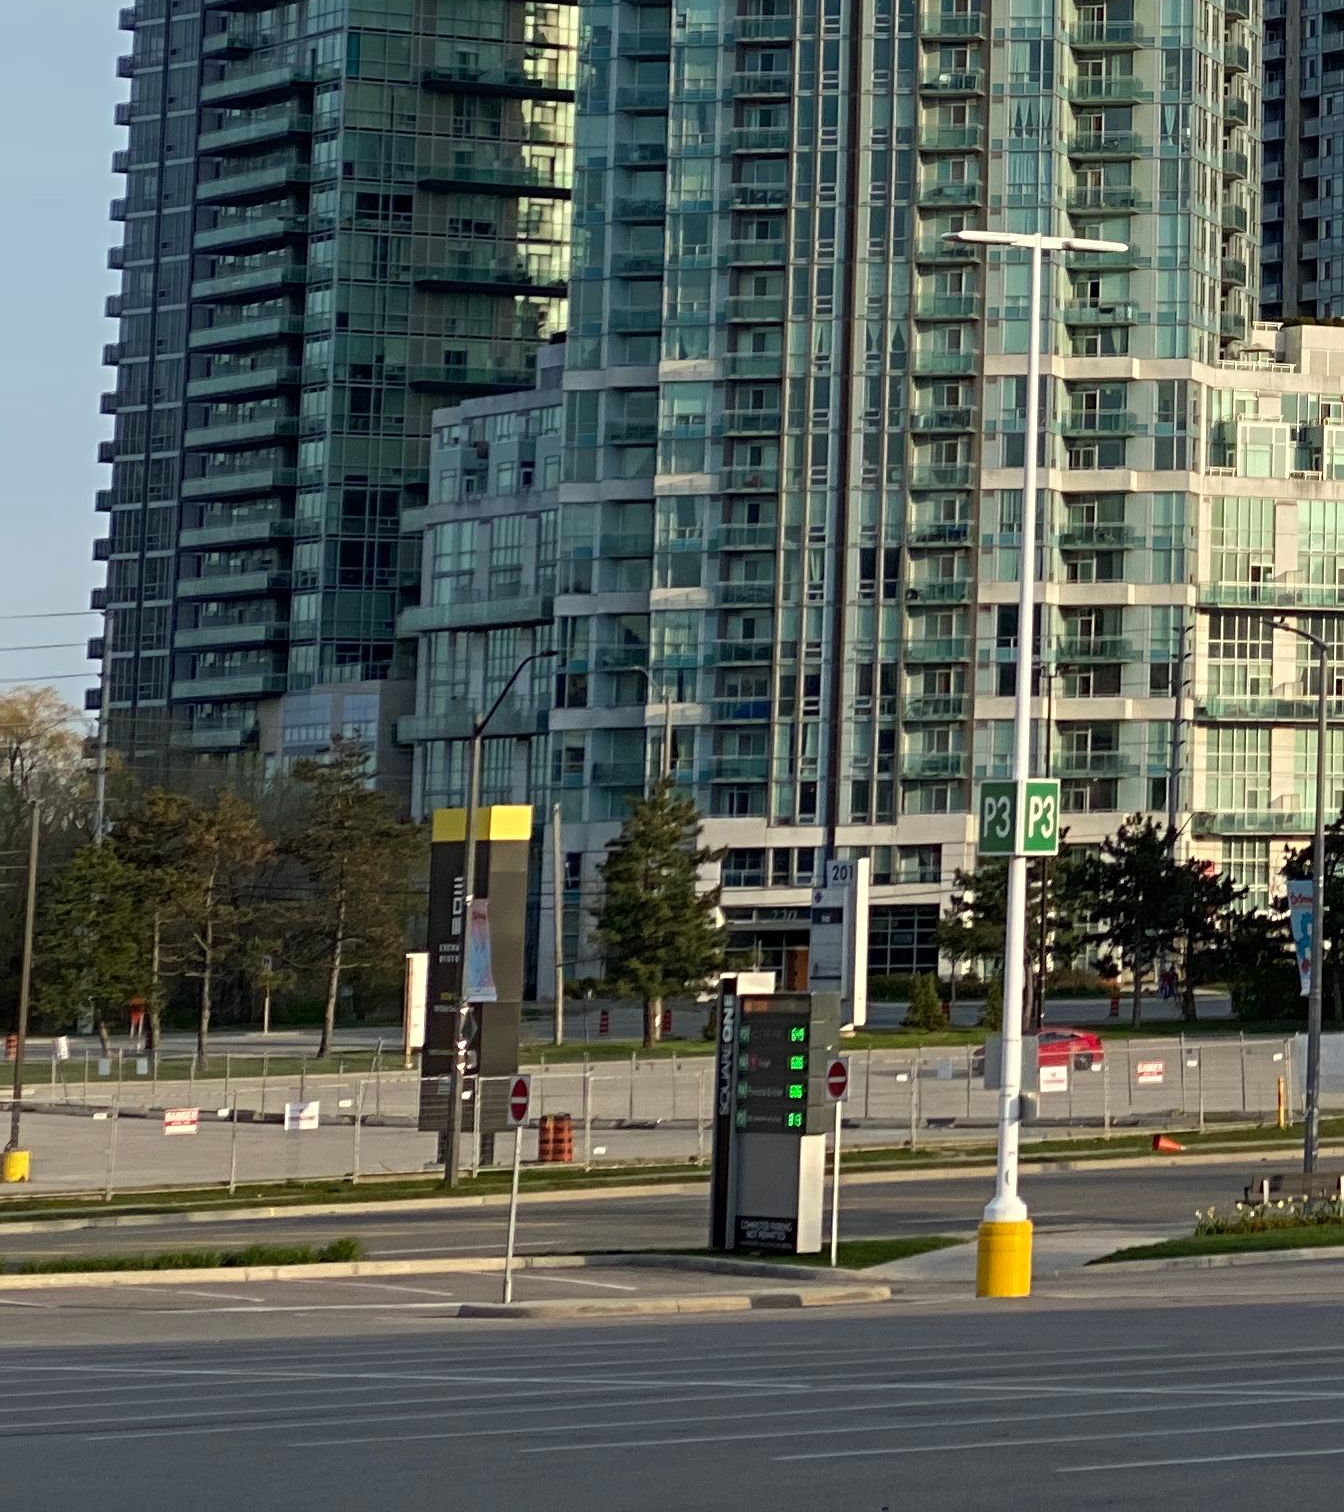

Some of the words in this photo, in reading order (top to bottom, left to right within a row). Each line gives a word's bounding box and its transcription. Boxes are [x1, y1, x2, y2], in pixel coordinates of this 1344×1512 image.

[983, 795, 1011, 838] P3
[1028, 795, 1055, 839] P3
[832, 865, 854, 881] 201
[722, 994, 735, 1042] ONE
[719, 1043, 733, 1115] SQUARE
